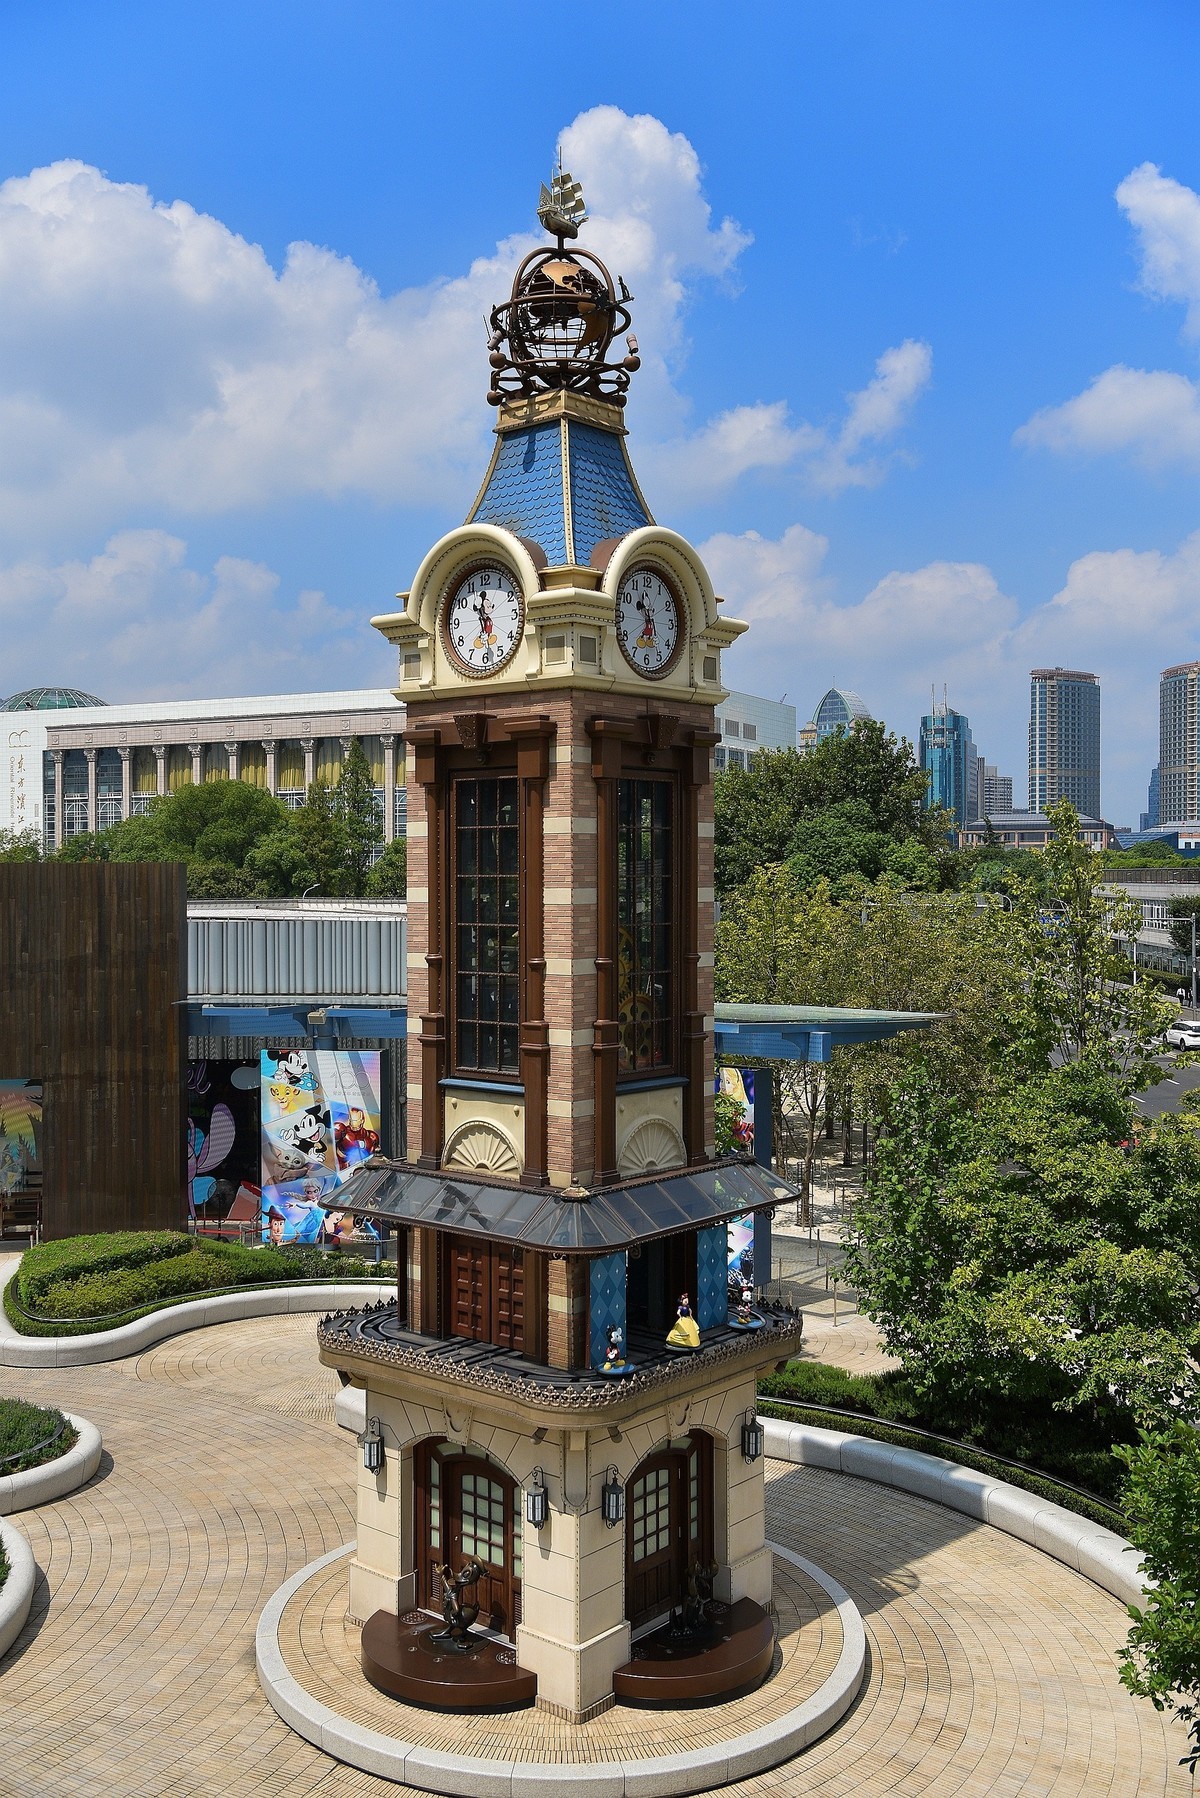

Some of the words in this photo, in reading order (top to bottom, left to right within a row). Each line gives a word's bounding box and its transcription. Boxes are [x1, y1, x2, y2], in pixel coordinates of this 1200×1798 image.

[479, 574, 491, 587] 12
[497, 577, 502, 589] 1
[632, 579, 638, 591] 11
[643, 576, 652, 588] 12
[467, 581, 475, 594] 11
[658, 585, 661, 595] 1
[507, 591, 514, 602] 2
[622, 591, 632, 604] 10
[457, 598, 468, 609] 10
[665, 601, 671, 611] 2
[511, 609, 518, 620] 3
[619, 611, 624, 622] 9
[453, 618, 460, 629] 9
[668, 619, 674, 630] 3
[507, 630, 514, 641] 4
[622, 630, 629, 641] 8
[457, 636, 465, 647] 8
[664, 639, 670, 649] 4
[468, 649, 475, 660] 7
[496, 646, 504, 657] 5
[631, 647, 638, 658] 7
[656, 651, 662, 662] 5
[482, 653, 489, 664] 6
[643, 654, 649, 665] 6
